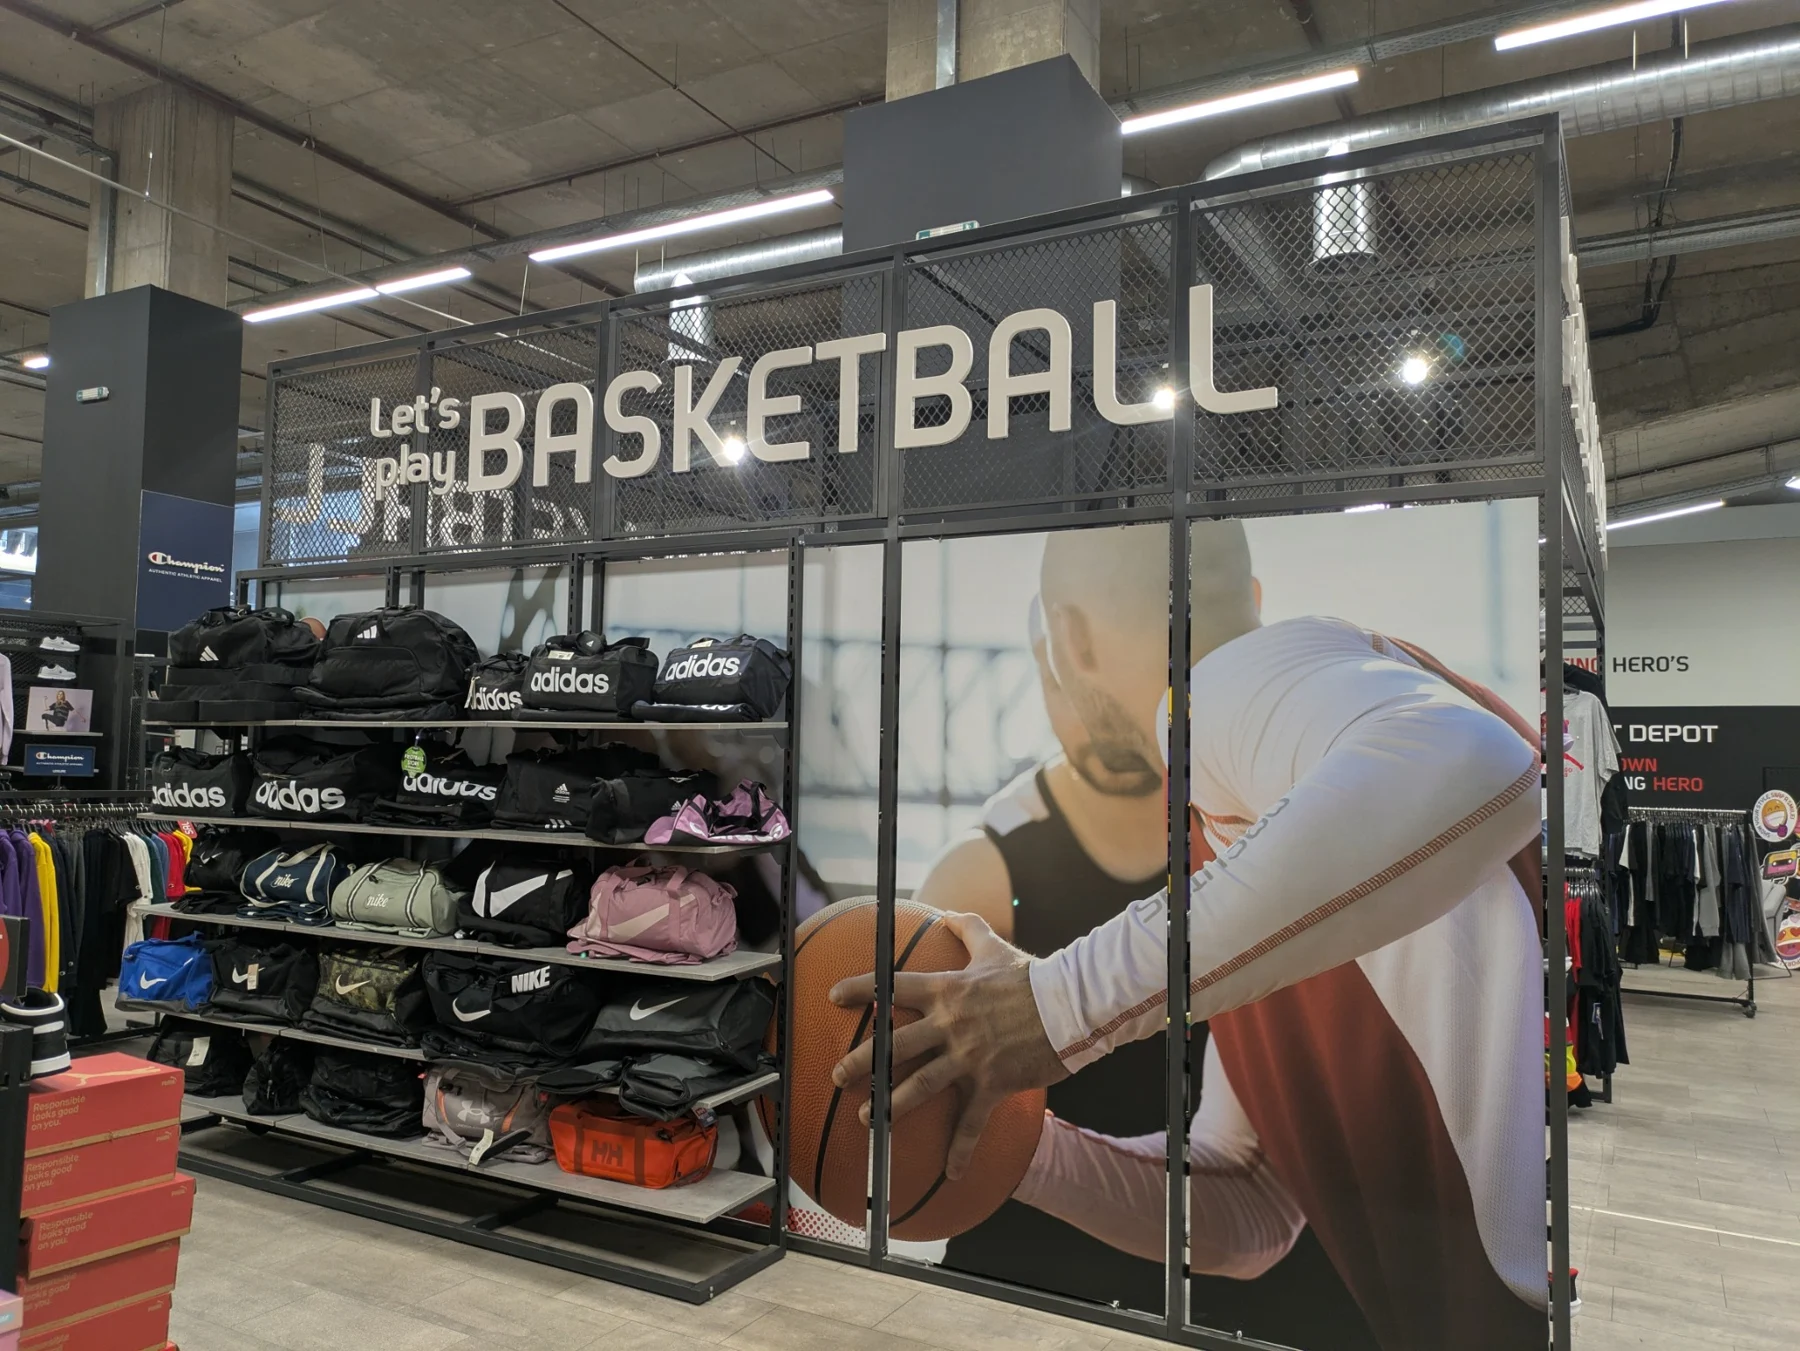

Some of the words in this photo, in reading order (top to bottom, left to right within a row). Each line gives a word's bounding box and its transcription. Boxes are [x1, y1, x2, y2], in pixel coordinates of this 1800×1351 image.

[468, 283, 1278, 493] BASKETBALL
[371, 387, 460, 438] Let's
[376, 444, 456, 500] play
[148, 551, 225, 574] Champion
[148, 568, 176, 577] AUTHENTIC
[177, 572, 200, 580] ATHLETIC
[201, 575, 222, 583] APPAREL
[665, 653, 740, 681] adidas
[1613, 656, 1689, 673] HERO'S
[531, 667, 610, 694] adidas
[466, 687, 523, 710] didas
[1629, 725, 1718, 743] DEPOT
[35, 752, 85, 762] Champion
[1653, 777, 1704, 791] HERO
[181, 821, 194, 835] SAL
[511, 965, 551, 994] NIKE
[33, 1096, 86, 1112] Responsible
[58, 1105, 79, 1118] good
[591, 1139, 624, 1167] HH
[51, 1164, 73, 1178] good
[64, 1221, 87, 1236] good
